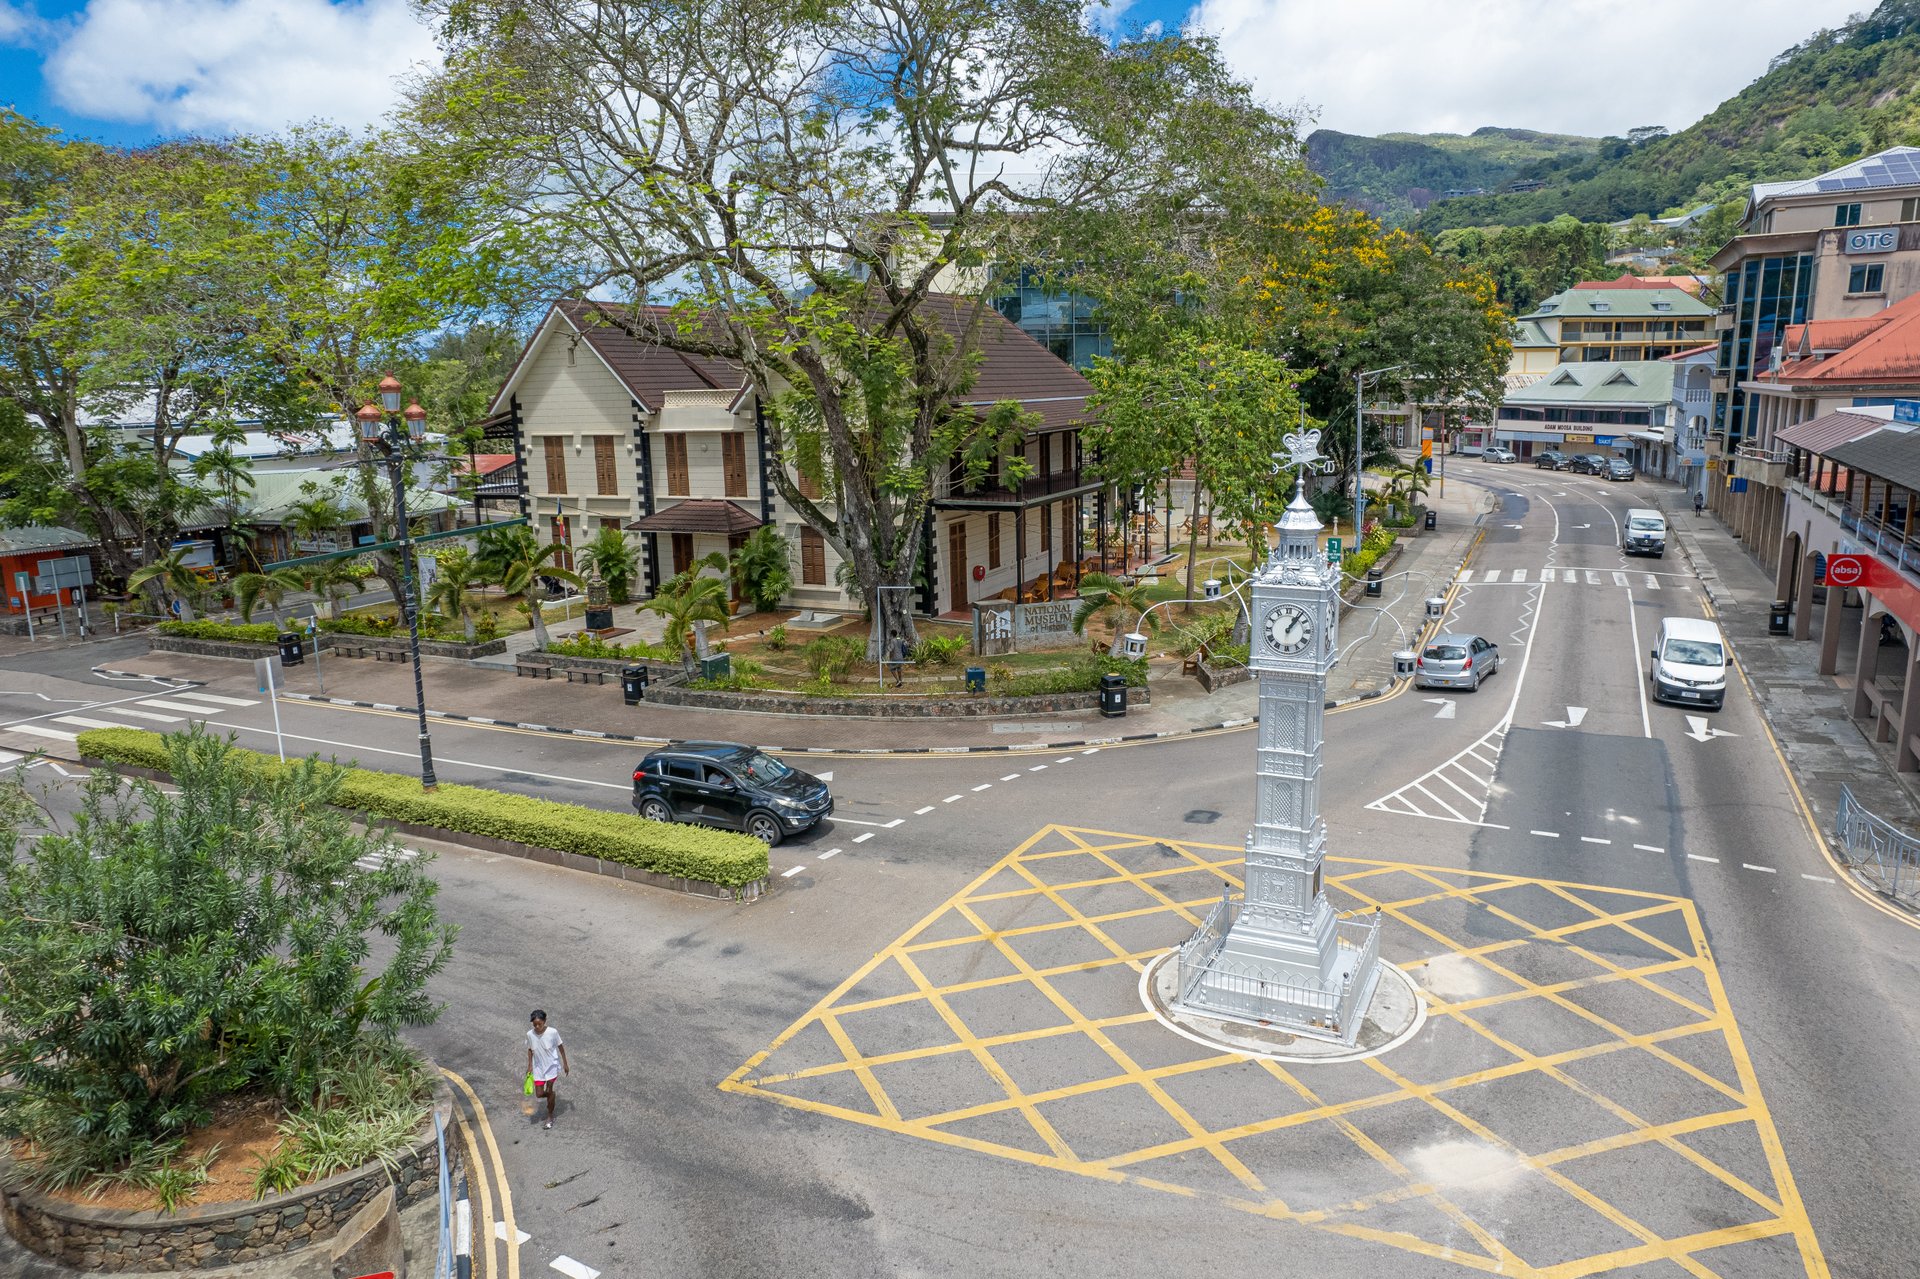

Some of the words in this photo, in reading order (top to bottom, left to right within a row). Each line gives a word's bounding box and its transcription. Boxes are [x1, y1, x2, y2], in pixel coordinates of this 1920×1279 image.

[1851, 232, 1894, 249] OTC
[1834, 565, 1858, 574] absa
[1024, 604, 1072, 616] NATIONAL
[1025, 613, 1072, 625] MUSEUM
[1041, 623, 1068, 633] History
